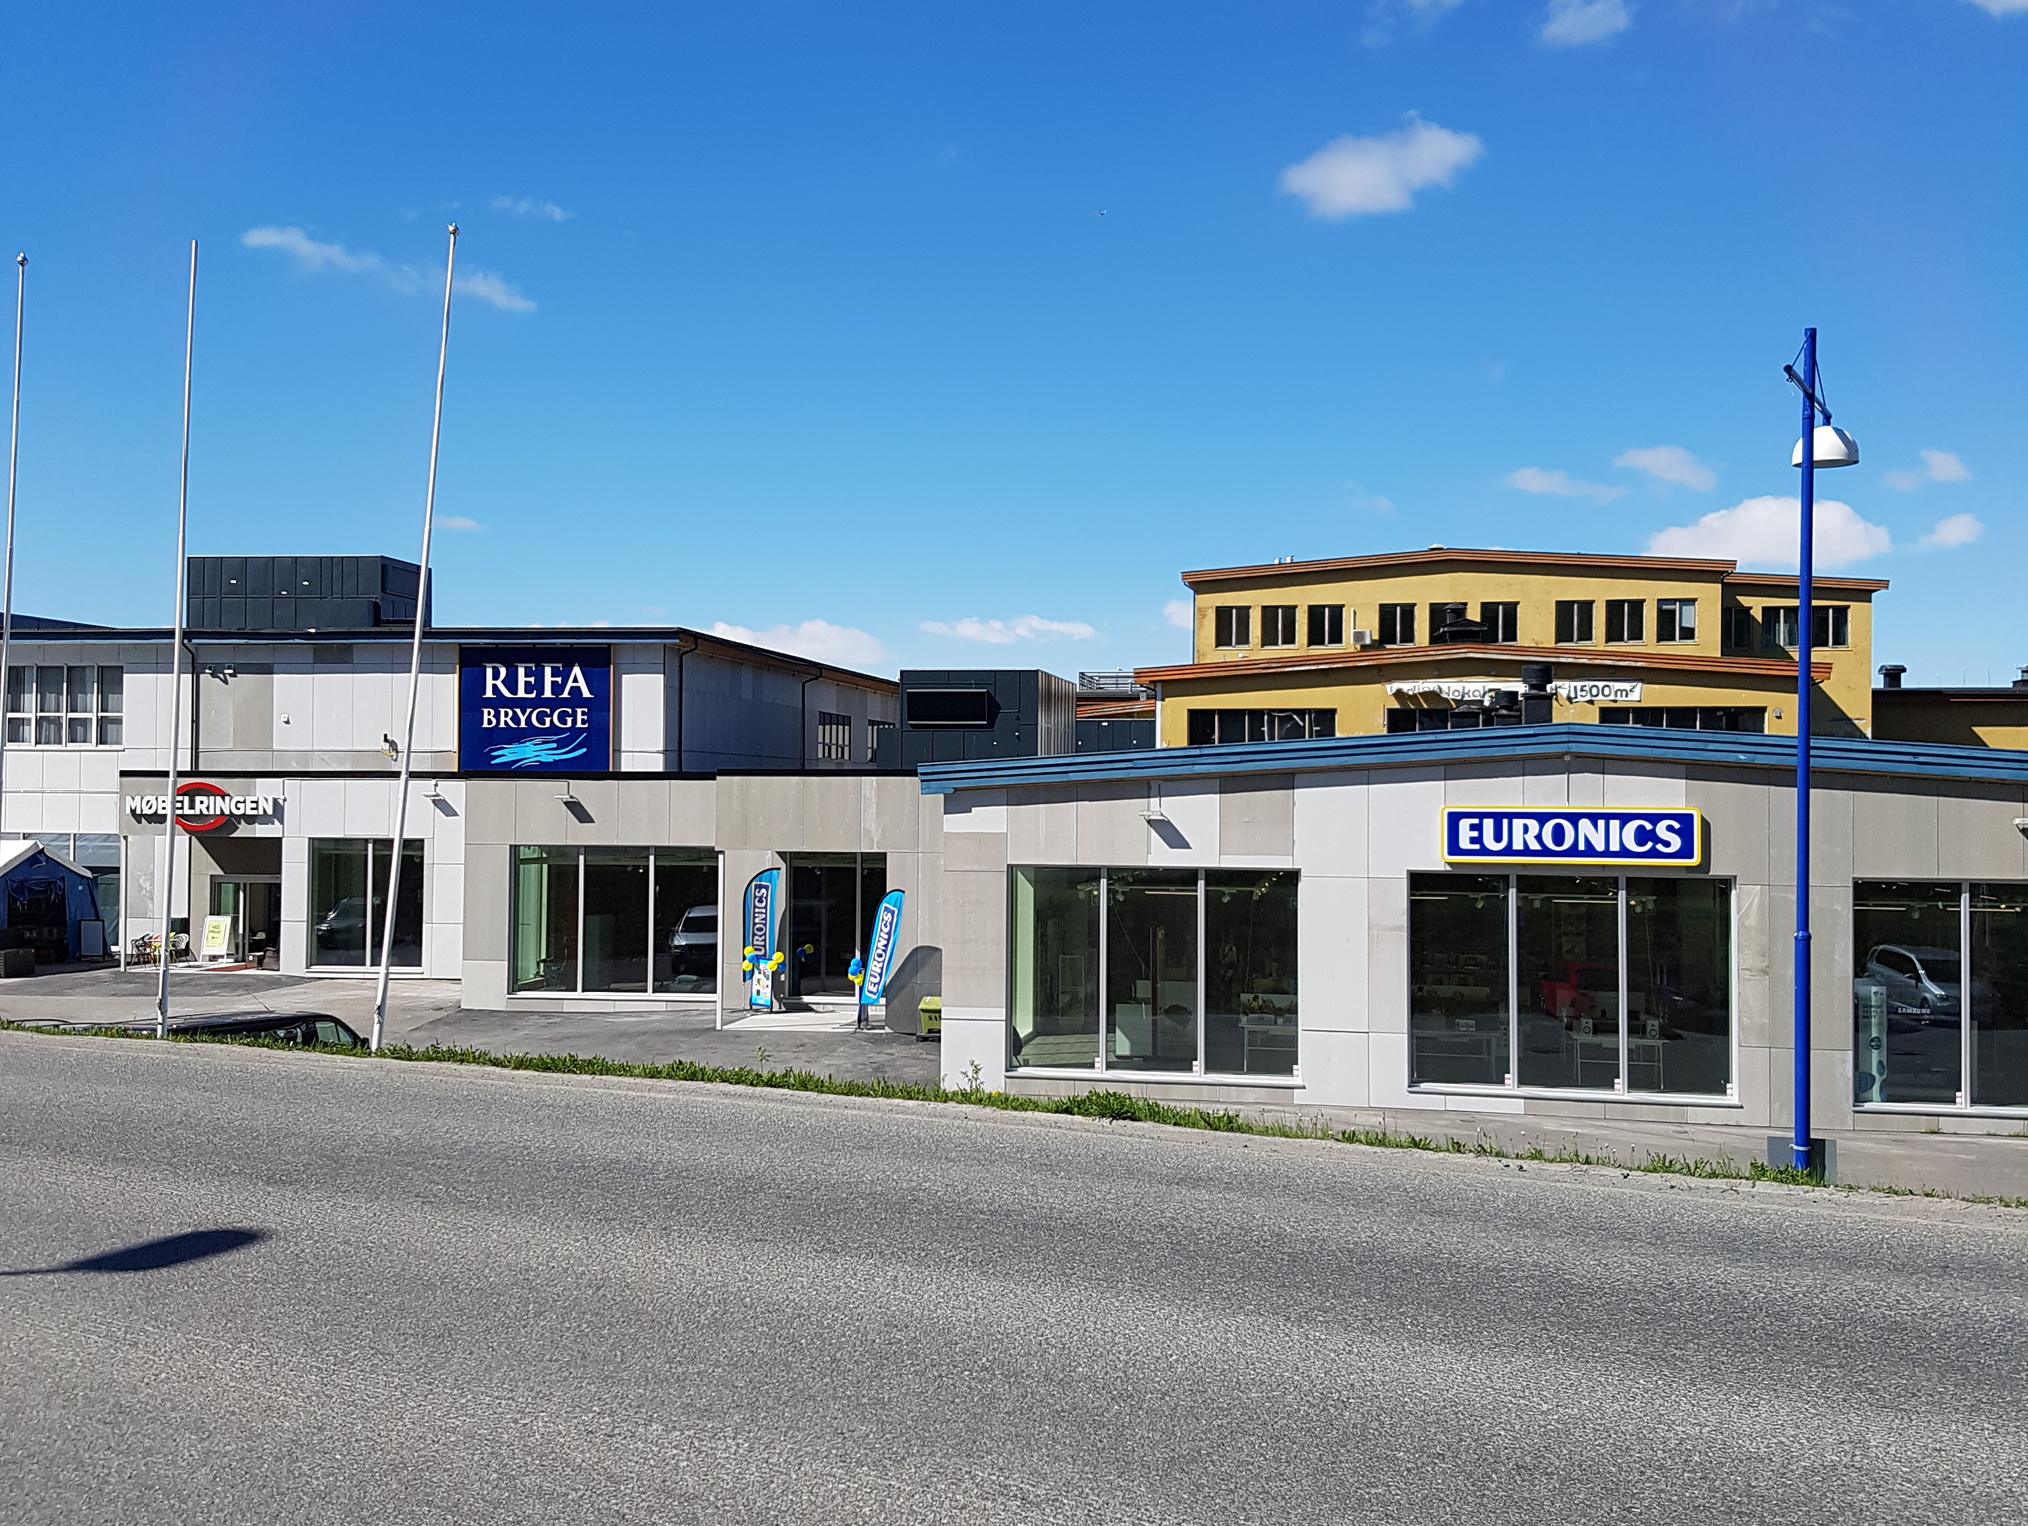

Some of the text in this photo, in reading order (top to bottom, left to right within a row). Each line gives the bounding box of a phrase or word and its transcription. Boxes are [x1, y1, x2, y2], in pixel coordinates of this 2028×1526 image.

[482, 662, 594, 698] REFA
[1573, 684, 1612, 699] 1500
[481, 708, 588, 728] BRYGGE
[125, 795, 273, 815] MØBELRINGEN
[1459, 818, 1681, 852] EURONICS
[753, 887, 767, 957] URONICS
[868, 910, 893, 994] EURONICS
